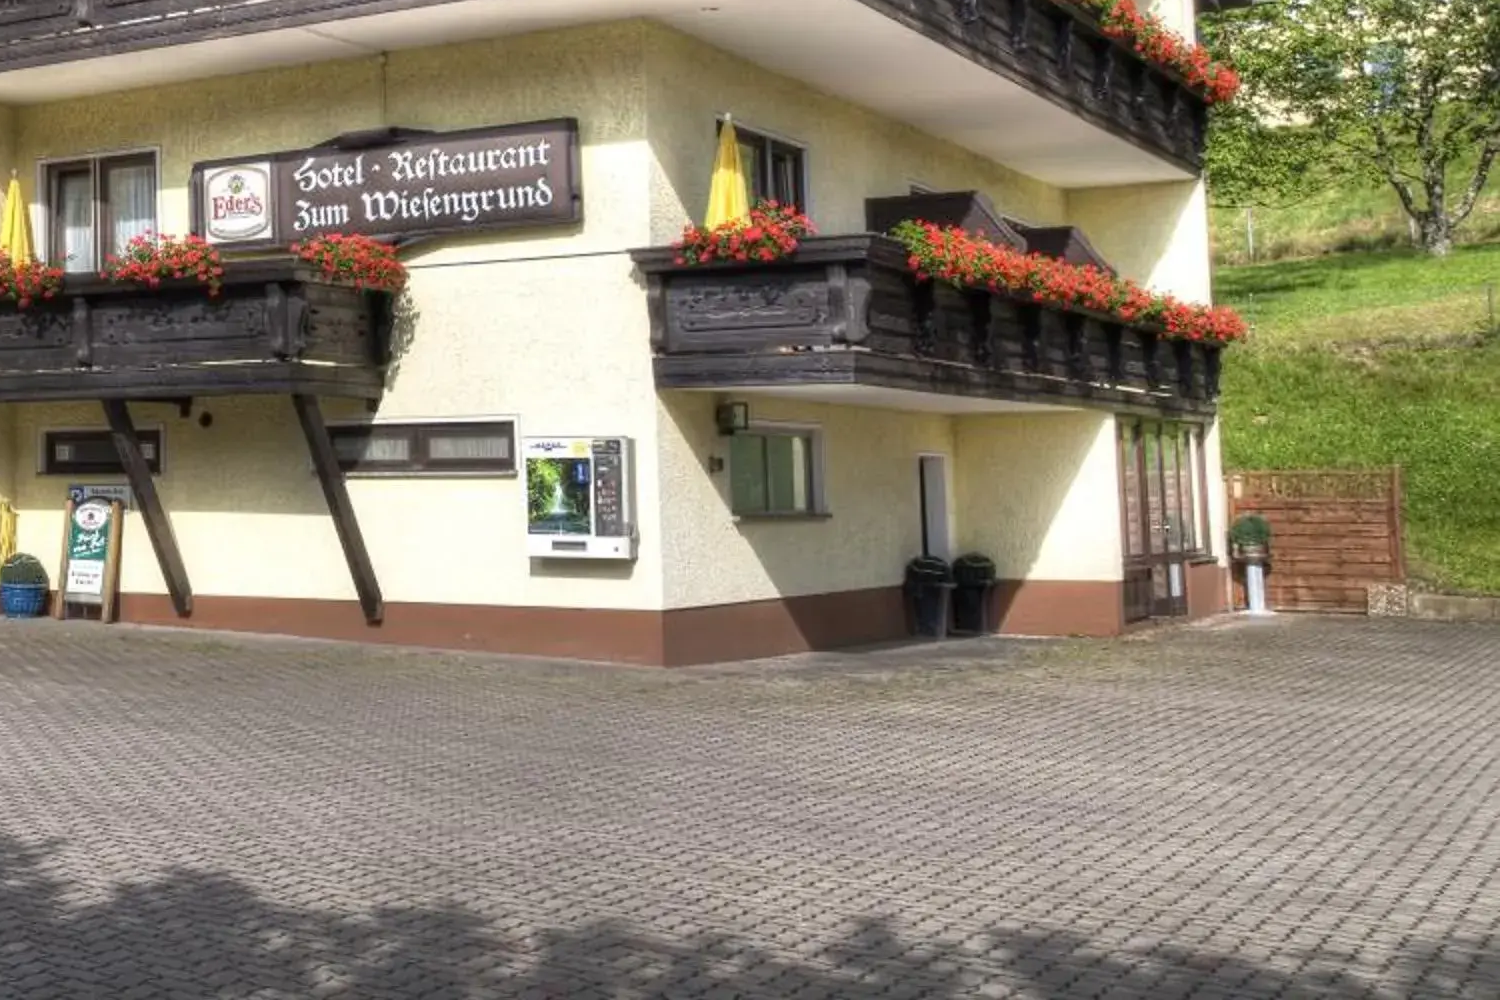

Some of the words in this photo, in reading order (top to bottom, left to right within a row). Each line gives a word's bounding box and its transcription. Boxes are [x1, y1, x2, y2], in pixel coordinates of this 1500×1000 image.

[293, 153, 366, 191] Hotel
[212, 192, 263, 220] Eder's
[293, 200, 350, 231] Zum
